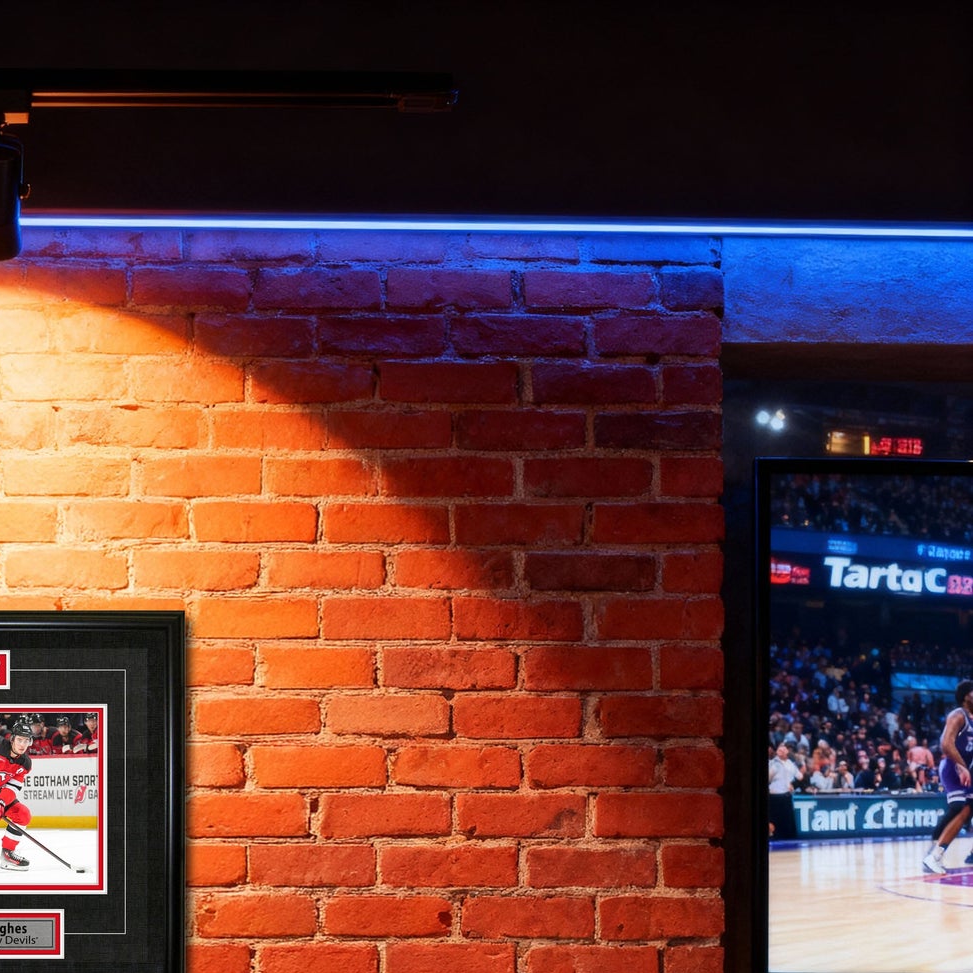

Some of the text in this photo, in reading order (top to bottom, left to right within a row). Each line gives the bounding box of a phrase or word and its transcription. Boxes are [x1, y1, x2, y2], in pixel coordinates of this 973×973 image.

[33, 775, 69, 786] GOTHAM
[23, 789, 55, 800] STREAM
[56, 789, 73, 800] LIVE
